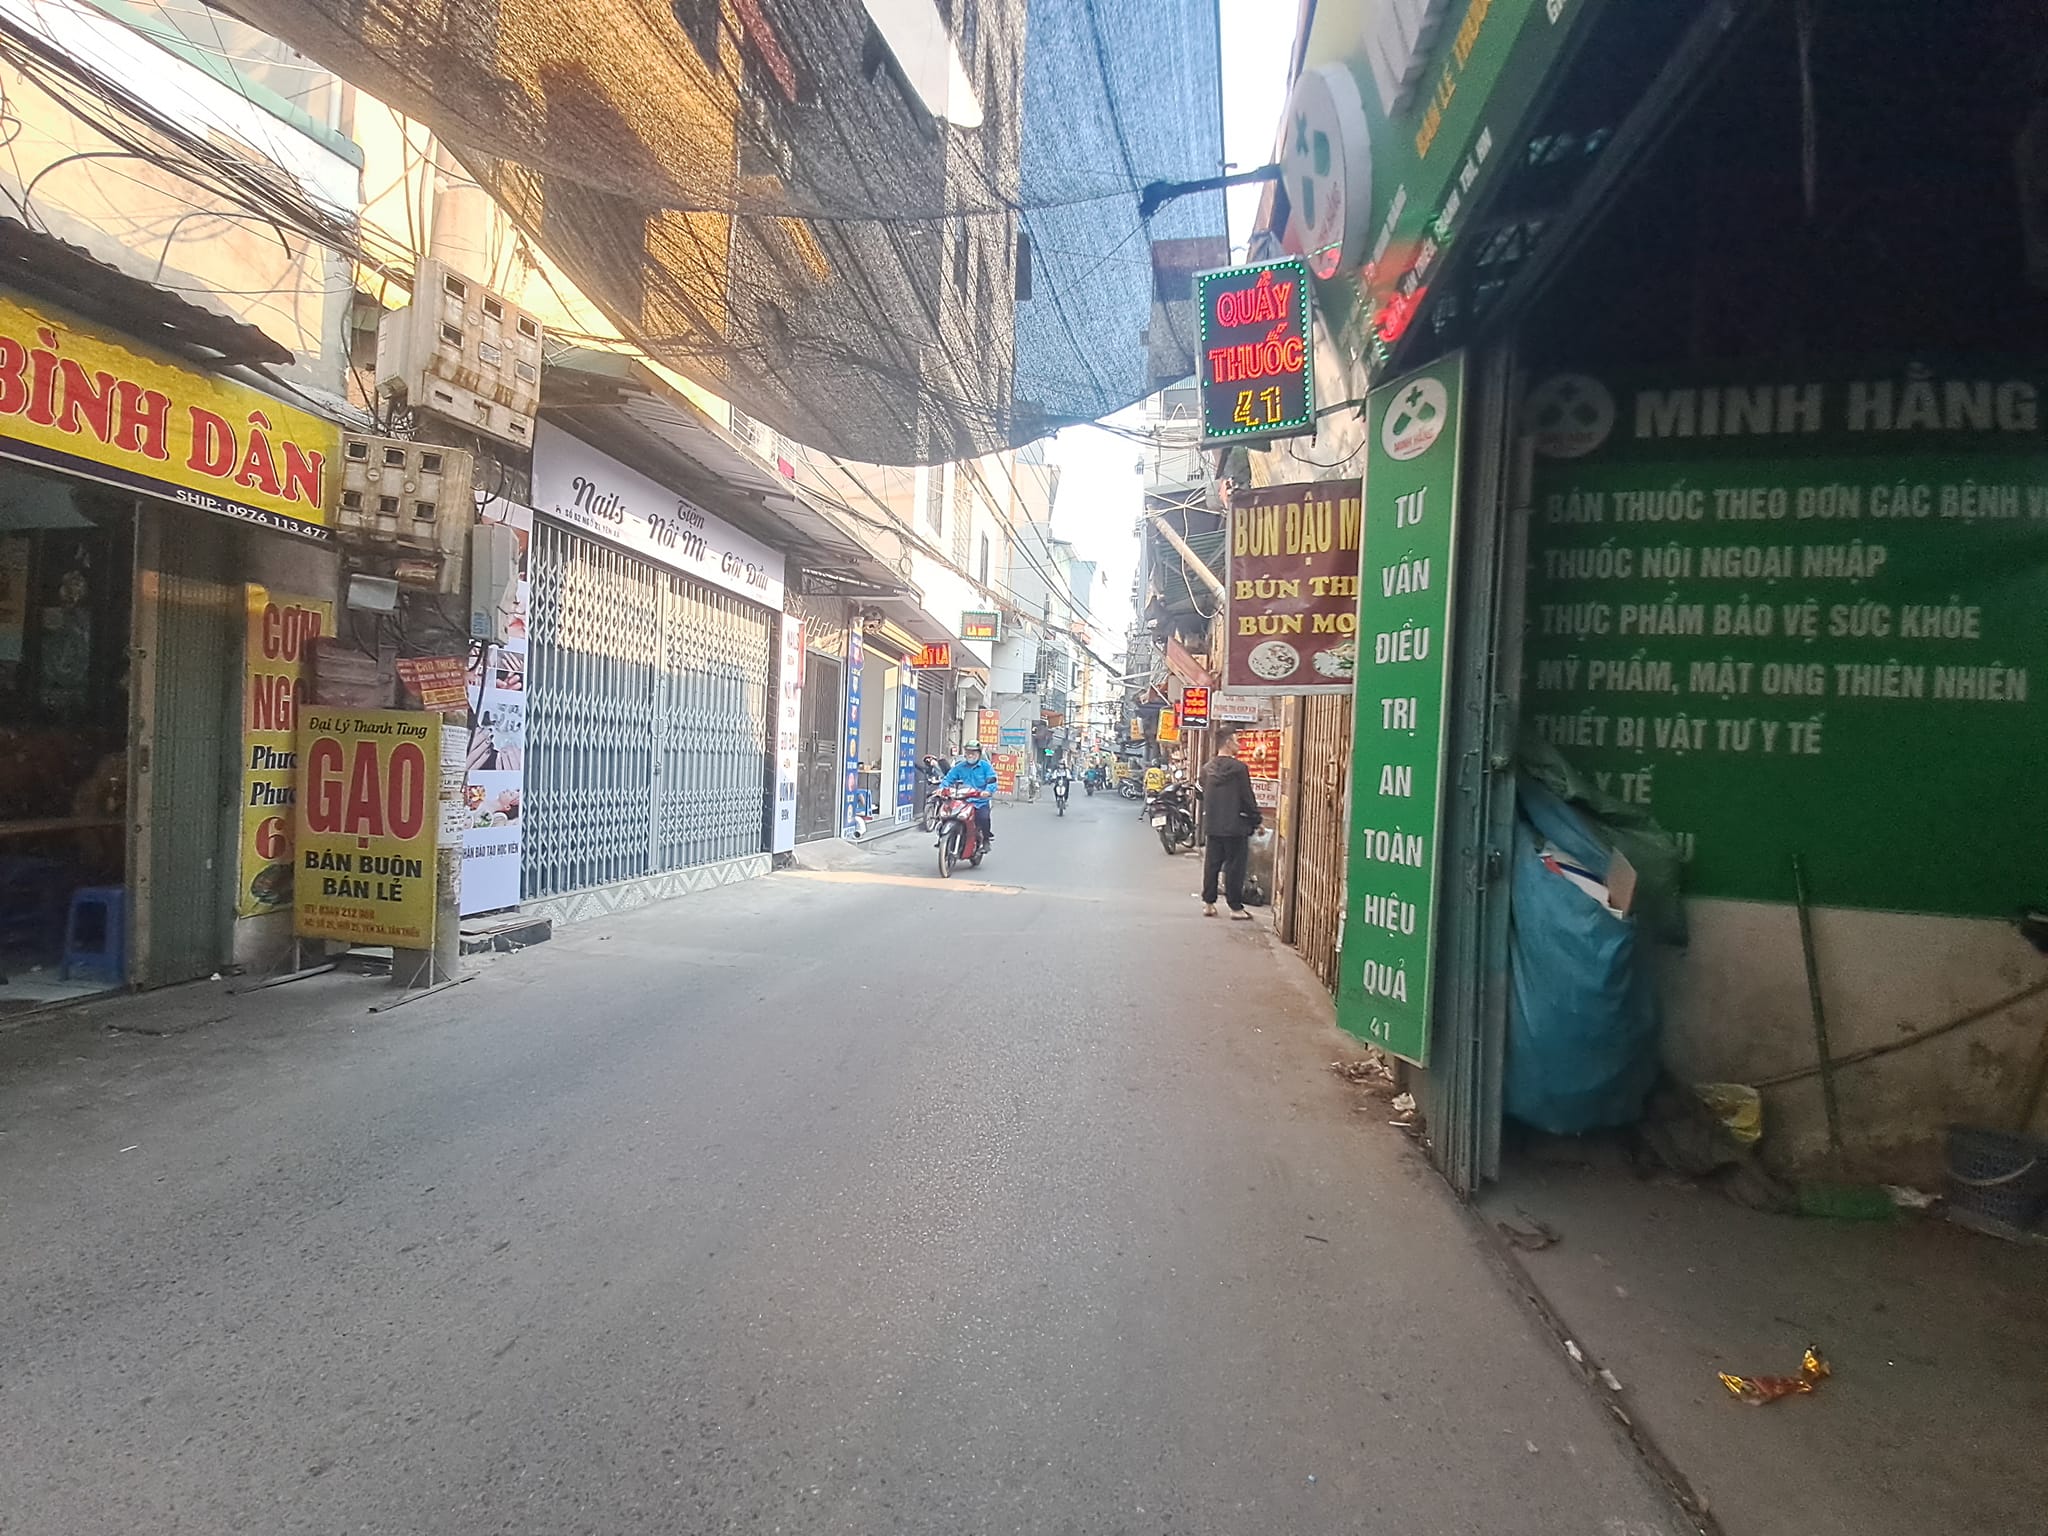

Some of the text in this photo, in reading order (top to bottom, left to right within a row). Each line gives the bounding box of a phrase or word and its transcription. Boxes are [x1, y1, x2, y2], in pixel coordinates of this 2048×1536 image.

[1209, 322, 1304, 383] THUỐC
[1233, 386, 1281, 426] 41
[1635, 385, 1822, 438] MINH
[186, 410, 325, 508] DÂN
[176, 489, 222, 511] SHIP:
[226, 504, 268, 523] 0976
[273, 516, 299, 532] 113
[572, 477, 626, 524] Nails
[682, 530, 708, 562] Mi
[677, 500, 705, 529] Tiệm
[1395, 486, 1427, 528] TƯ
[1549, 487, 1604, 523] BÁN
[1612, 478, 1704, 522] THUỐC
[1713, 488, 1787, 520] THEO
[1870, 478, 1930, 518] CÁC
[1940, 479, 2018, 525] BỆNH
[1234, 496, 1279, 557] BÚN
[1286, 491, 1332, 566] ĐẬU
[1382, 549, 1430, 597] VẤN
[1544, 537, 1887, 585] THUỐC NỘI NGOẠI NHẬP
[1235, 574, 1300, 600] BÚN
[1238, 609, 1303, 636] BÚN
[1540, 590, 1981, 644] THỰC PHẨM BẢO VỆ SỨC KHỎE
[1537, 654, 1580, 690] MỸ
[1690, 656, 1755, 700] MẬT
[1762, 663, 1825, 695] ONG
[1835, 658, 1924, 698] THIÊN
[1933, 660, 2027, 701] NHIÊN
[310, 717, 331, 733] Đại
[354, 720, 392, 735] Thanh
[1381, 698, 1418, 738] TRỊ
[1534, 706, 1826, 756] THIẾT BỊ VẬT TƯ Y TẾ
[307, 737, 426, 850] GẠO
[1379, 765, 1412, 797] AN
[1621, 764, 1656, 804] TẾ
[305, 849, 423, 878] BÁN BUÔN
[1363, 825, 1423, 868] TOÀN
[322, 876, 403, 903] BÁN LẺ
[1364, 892, 1416, 938] HIỆU
[1363, 959, 1407, 1003] QUẢ
[1370, 1017, 1390, 1041] 41
